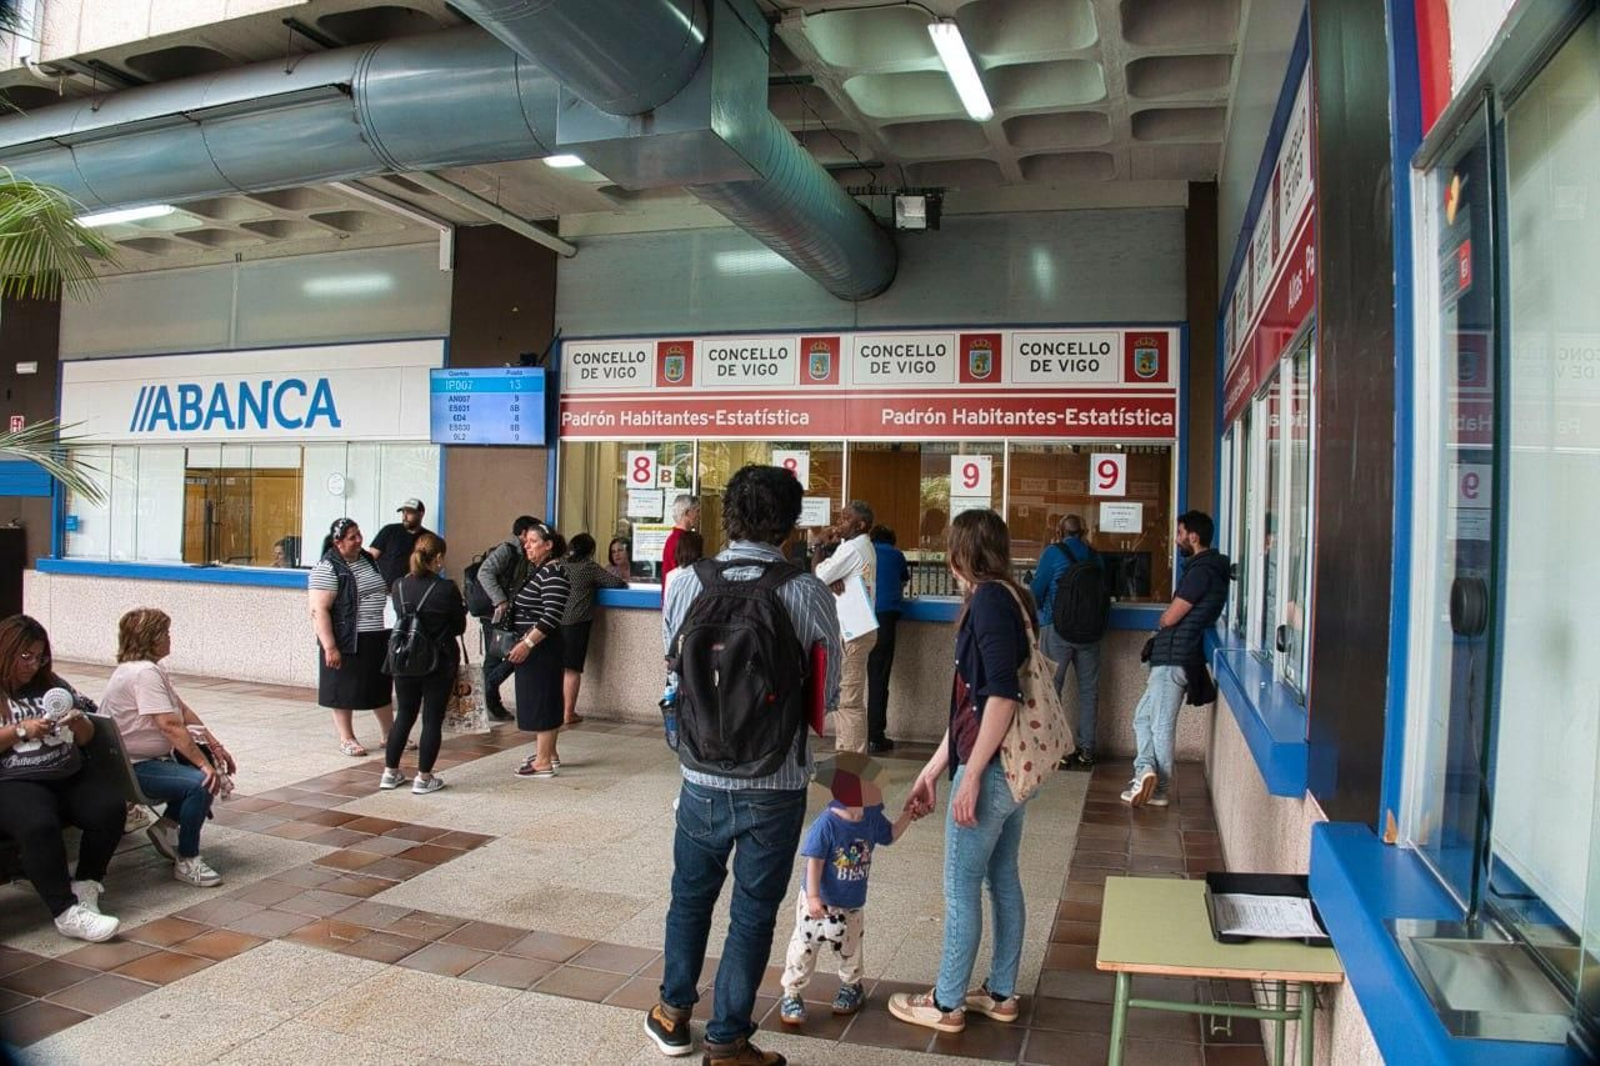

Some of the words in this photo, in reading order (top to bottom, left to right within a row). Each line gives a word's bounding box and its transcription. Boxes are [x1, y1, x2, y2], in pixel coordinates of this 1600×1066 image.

[709, 347, 788, 361] CONCELLO
[860, 344, 946, 358] CONCELLO
[1019, 342, 1111, 356] CONCELLO
[573, 351, 646, 365] CONCELLO
[581, 367, 598, 380] DE
[603, 366, 637, 379] VIGO
[717, 364, 737, 377] DE
[742, 363, 779, 376] VIGO
[870, 361, 891, 374] DE
[897, 361, 936, 374] VIGO
[1030, 360, 1052, 373] DE
[1058, 359, 1100, 373] VIGO
[561, 410, 615, 427] Padrón
[620, 409, 810, 427] Habitantes-Estatística
[881, 407, 946, 425] Padrón
[952, 407, 1173, 426] Habitantes-Estatística
[633, 456, 651, 483] 8
[660, 469, 672, 483] B
[962, 463, 980, 489] 9
[1097, 459, 1120, 489] 9
